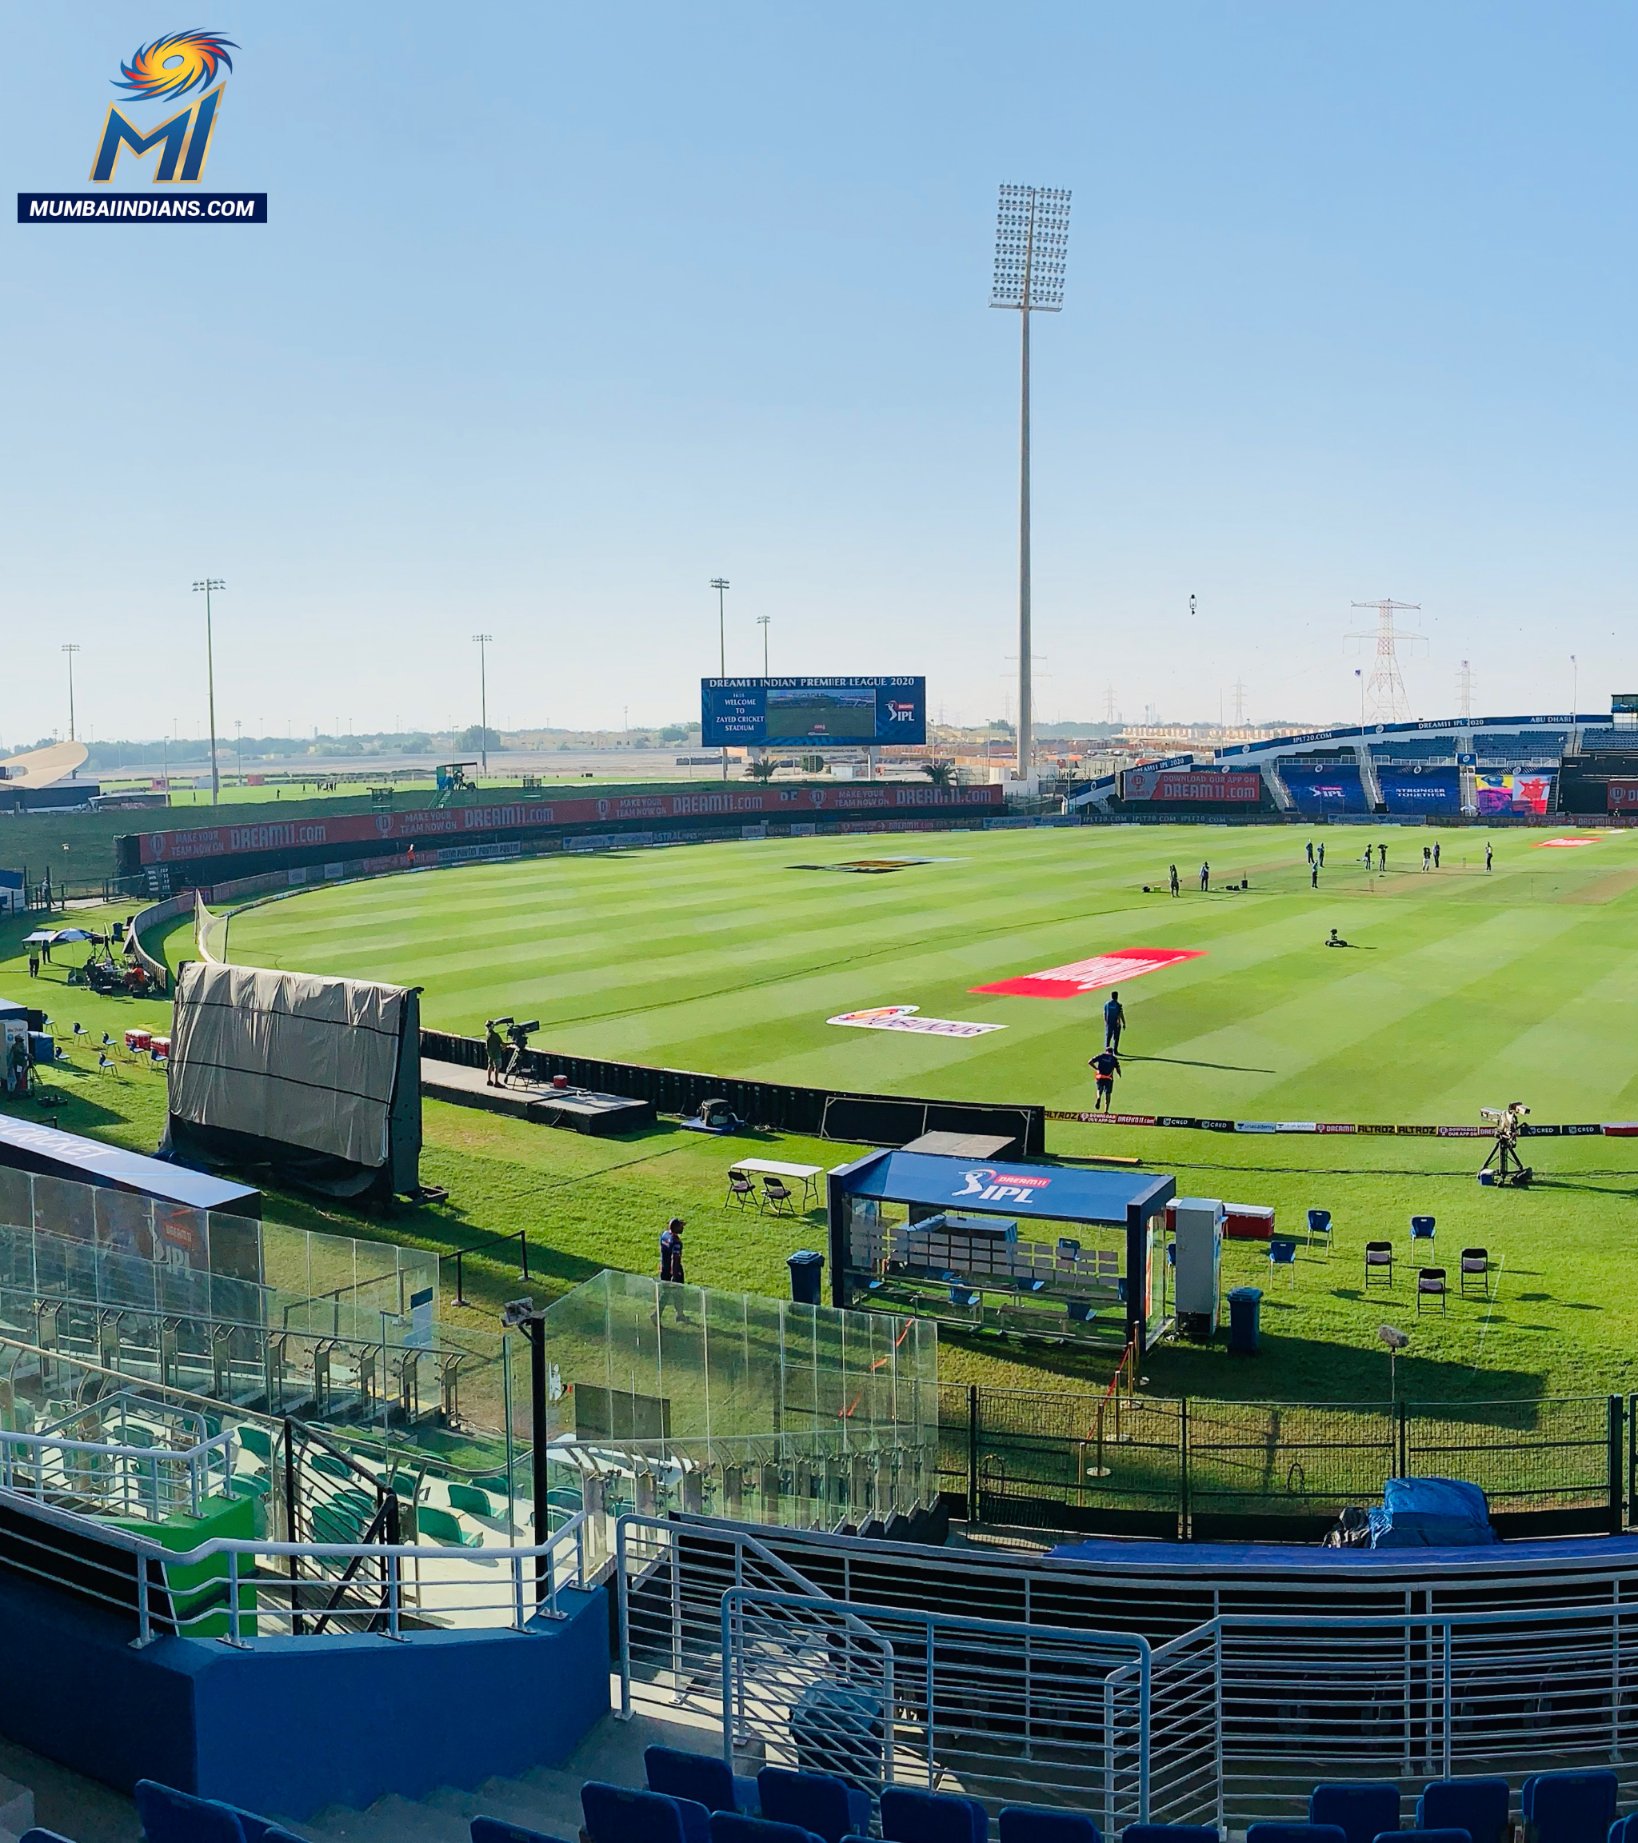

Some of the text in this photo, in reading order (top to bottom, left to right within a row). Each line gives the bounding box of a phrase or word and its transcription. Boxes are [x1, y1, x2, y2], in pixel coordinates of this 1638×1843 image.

[709, 679, 757, 688] DREAM11
[760, 679, 796, 687] INDIAN
[849, 678, 887, 686] LEAGUE
[890, 677, 914, 686] 2020
[737, 715, 764, 723] CRICKET
[897, 711, 915, 722] IPL
[1547, 715, 1572, 723] DHABI
[725, 724, 754, 732] STADIUM
[1418, 722, 1450, 730] DREAM11
[1293, 733, 1332, 743] IPLT20.COM
[1170, 757, 1185, 767] 2020
[1164, 775, 1206, 783] DOWNLOAD
[1209, 775, 1225, 783] OUR
[1227, 775, 1242, 783] APP
[838, 790, 885, 800] MAKE YOUR
[1165, 784, 1255, 799] DREAM11.com
[1324, 790, 1345, 798] IPL
[619, 798, 662, 808] MAKE YOUR
[834, 799, 890, 808] TEAM NOW ON
[405, 810, 452, 823] MAKE YOUR
[615, 808, 637, 817] TEAM
[638, 807, 656, 817] NOW
[400, 820, 457, 835] TEAM NOW ON
[175, 832, 198, 845] MAKE
[171, 844, 192, 858] TEAM
[1044, 1112, 1077, 1120] ALTROZ
[1358, 1125, 1395, 1133] ALTROZ
[1398, 1126, 1436, 1134] ALTROZ
[1, 1127, 120, 1160] CRICKET
[998, 1176, 1048, 1187] DREAM11
[978, 1185, 1034, 1203] IPL
[165, 1245, 195, 1281] IPL
